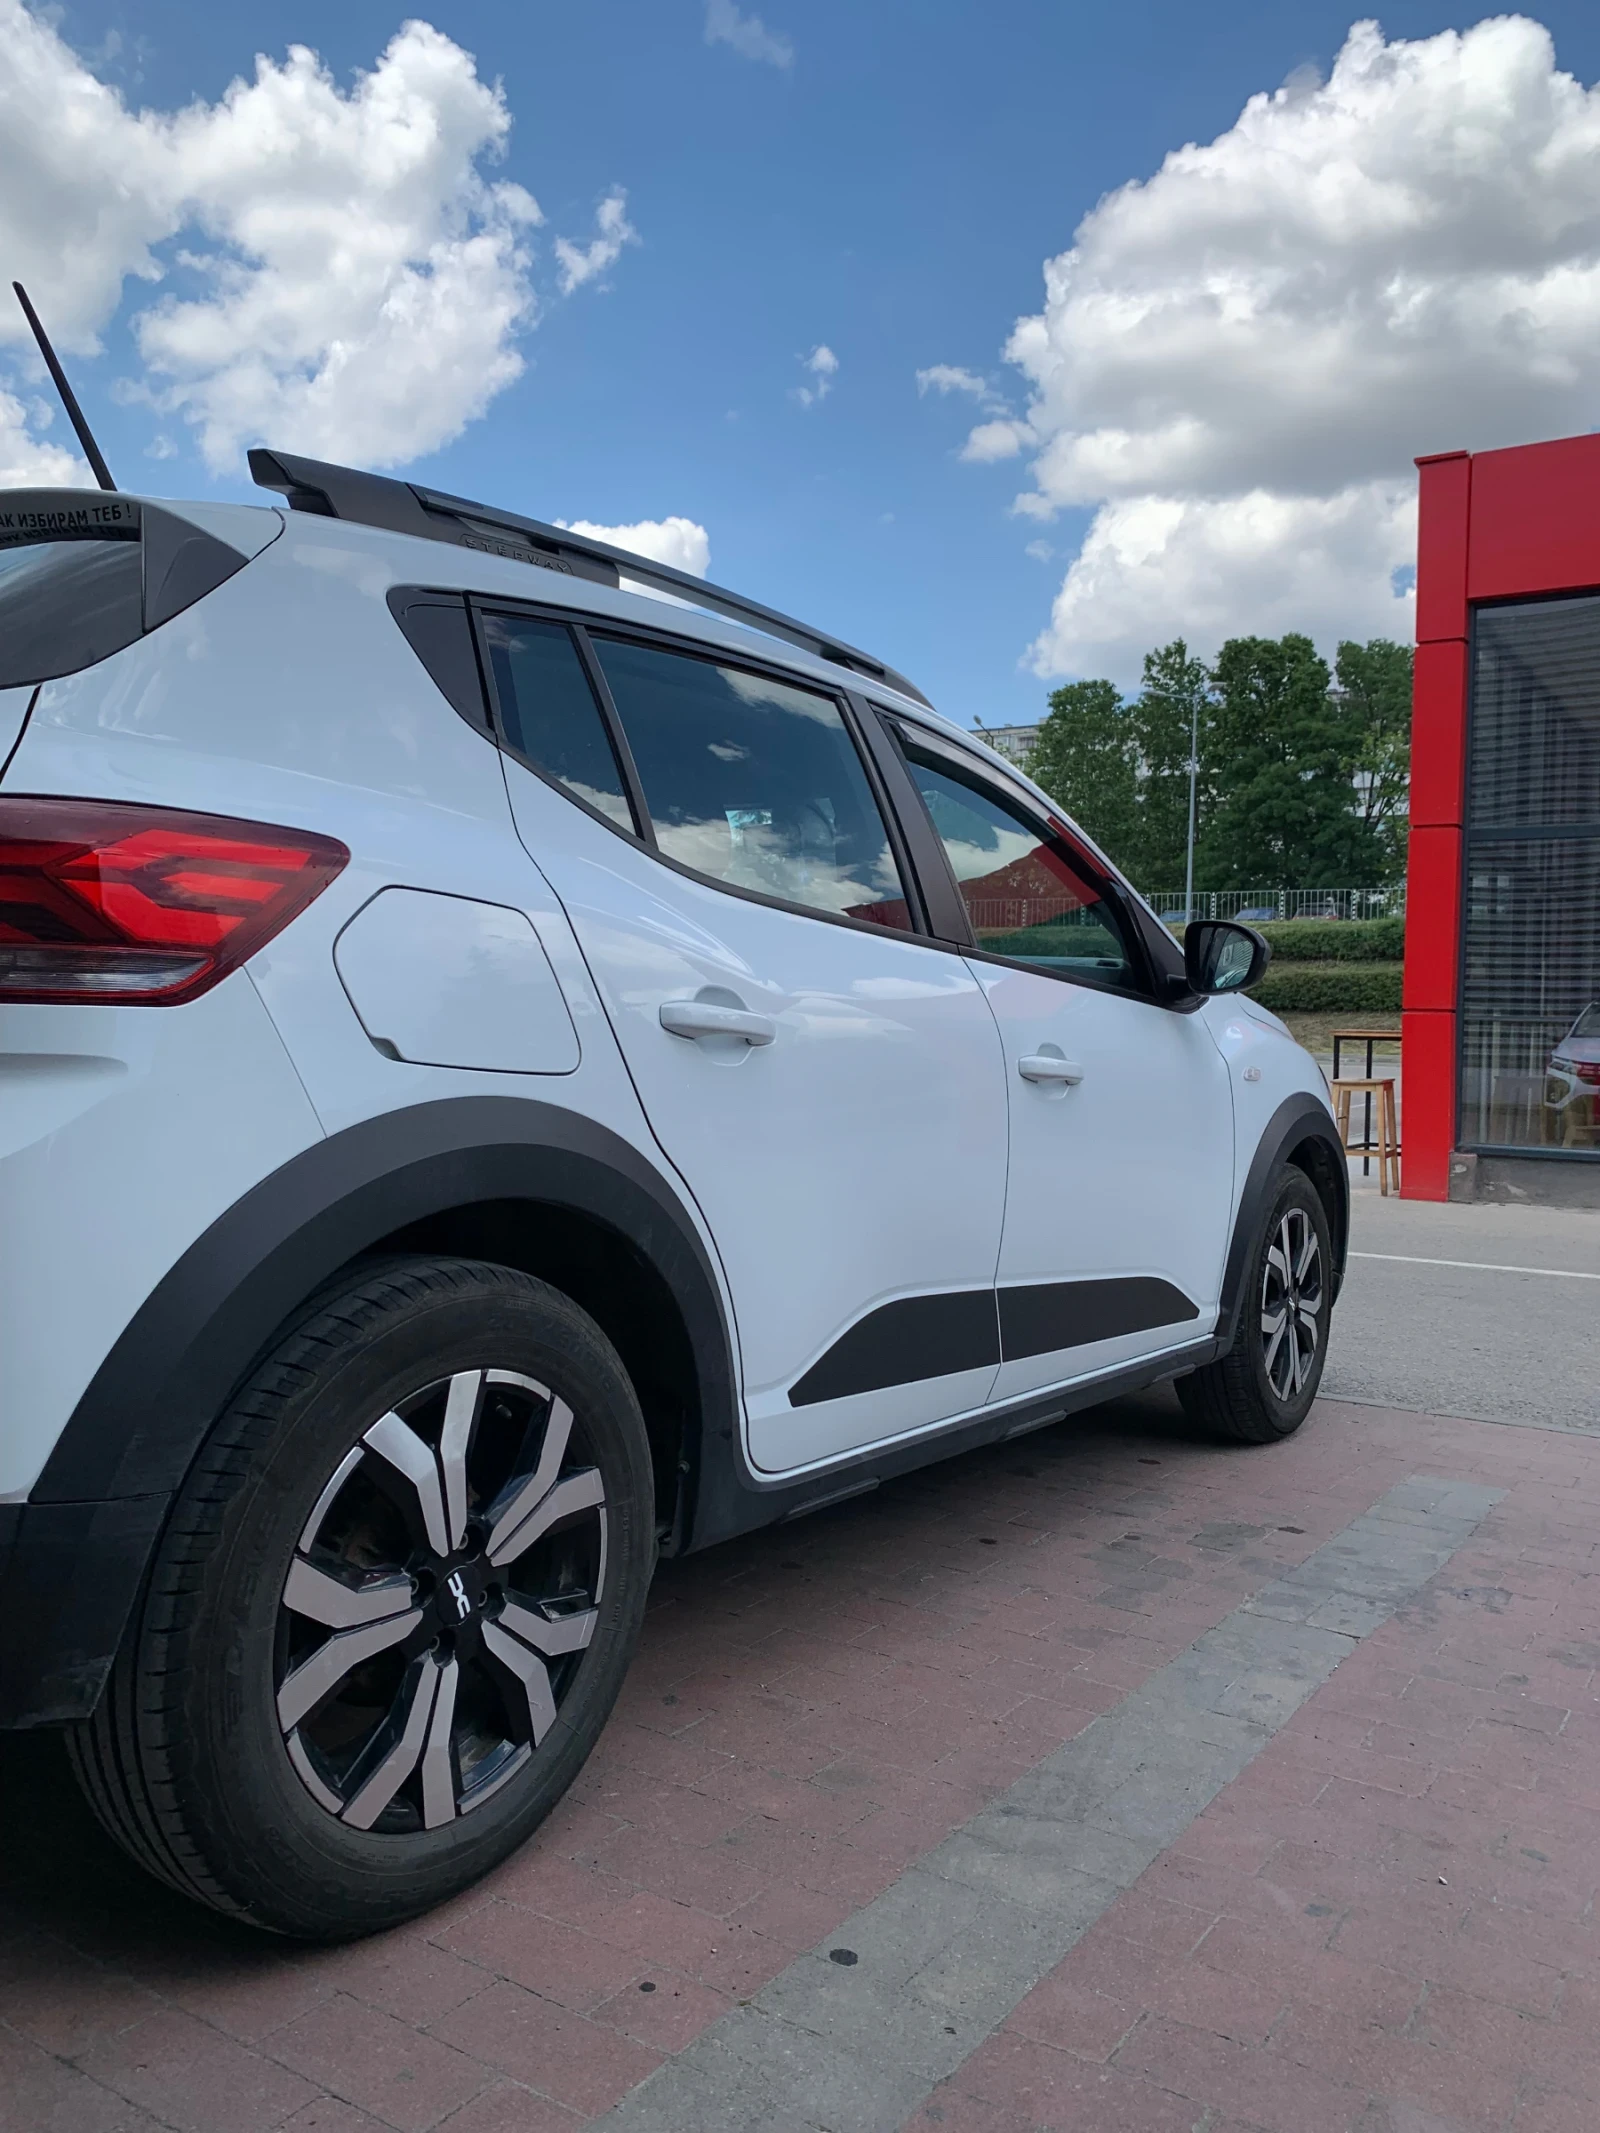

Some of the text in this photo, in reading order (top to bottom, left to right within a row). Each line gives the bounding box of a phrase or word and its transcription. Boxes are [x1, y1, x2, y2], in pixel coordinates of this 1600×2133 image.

[18, 510, 88, 528] ИЗБИРАМ
[92, 504, 122, 523] ТЕБ
[465, 538, 567, 573] STEPWAY
